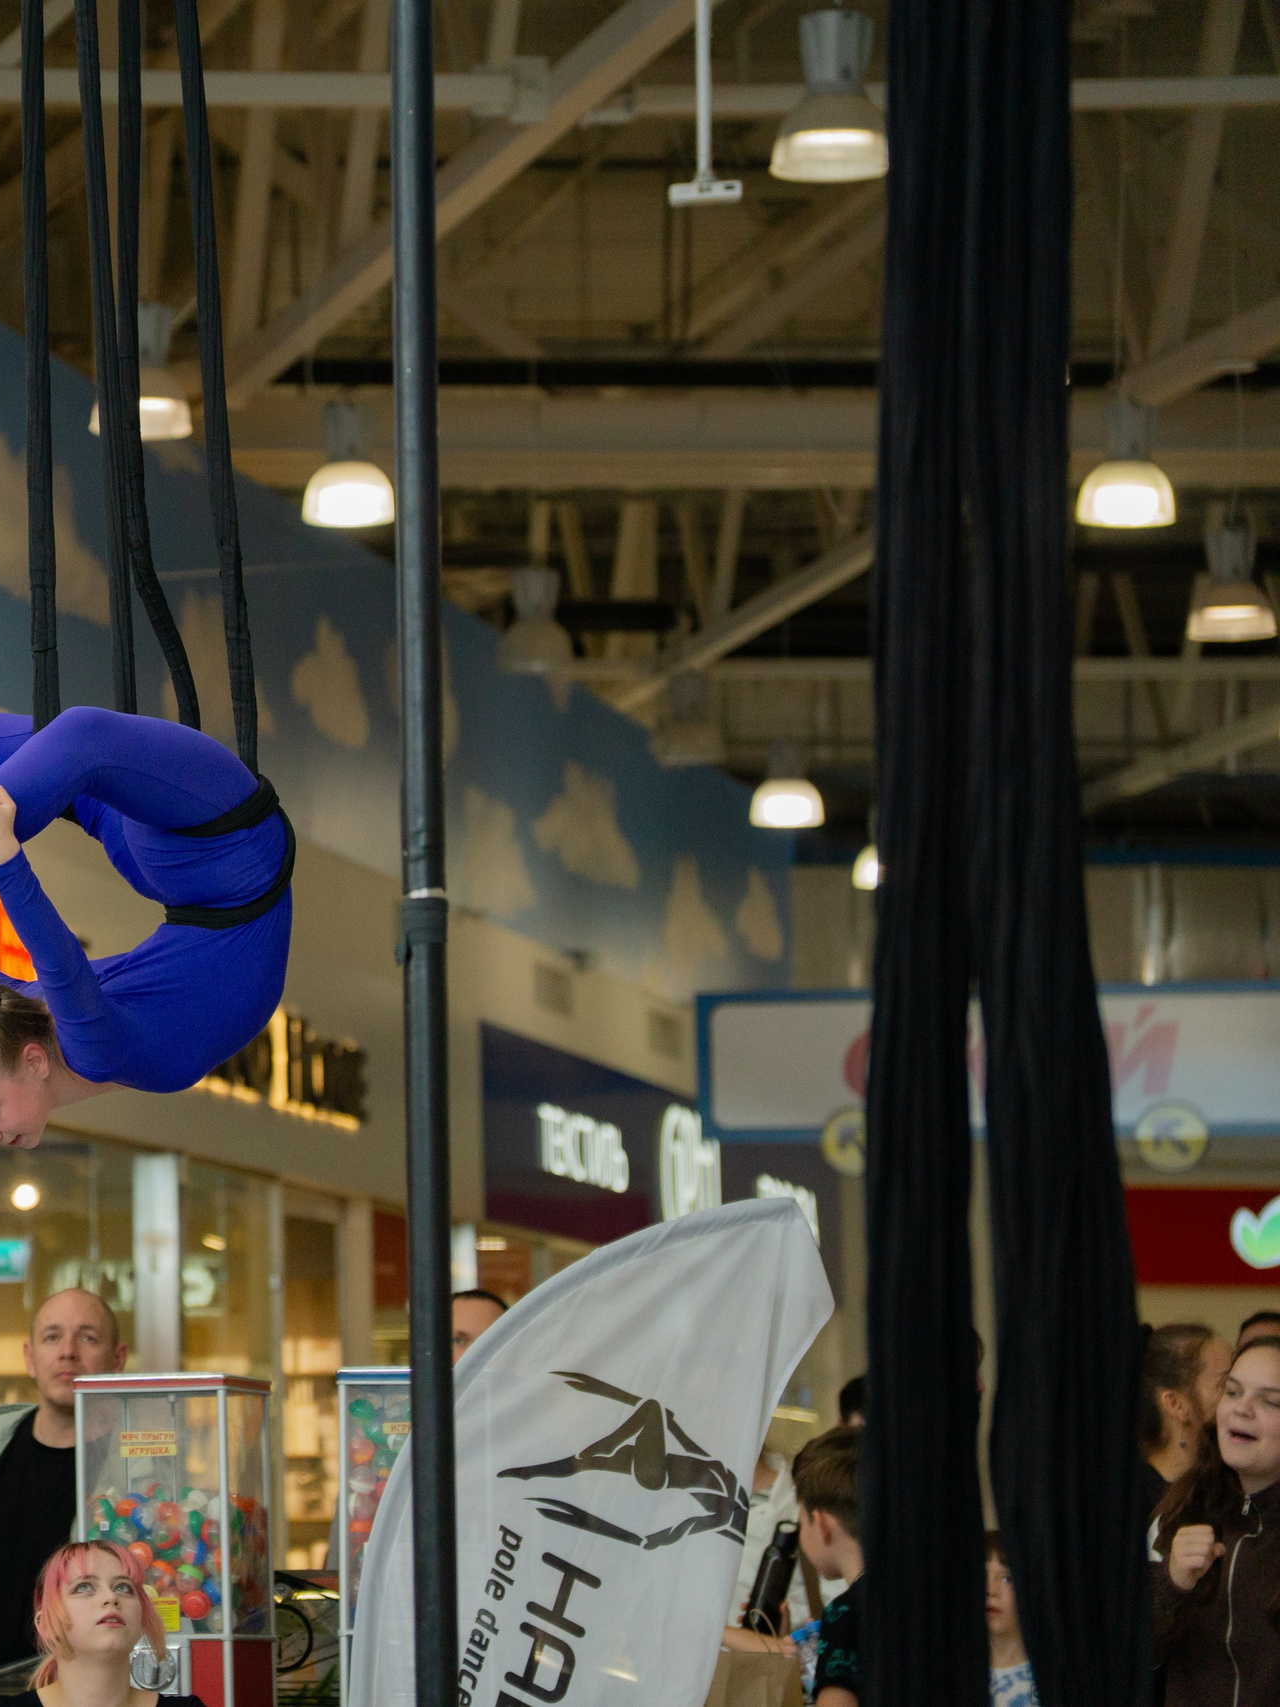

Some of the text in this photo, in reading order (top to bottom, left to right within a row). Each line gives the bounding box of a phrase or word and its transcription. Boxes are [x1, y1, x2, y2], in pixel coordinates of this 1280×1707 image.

[122, 1432, 174, 1441] МЯЧ ПРЫГУН
[128, 1446, 170, 1455] ИГРУШКА
[457, 1524, 523, 1707] pole dance
[495, 1551, 602, 1707] HA
